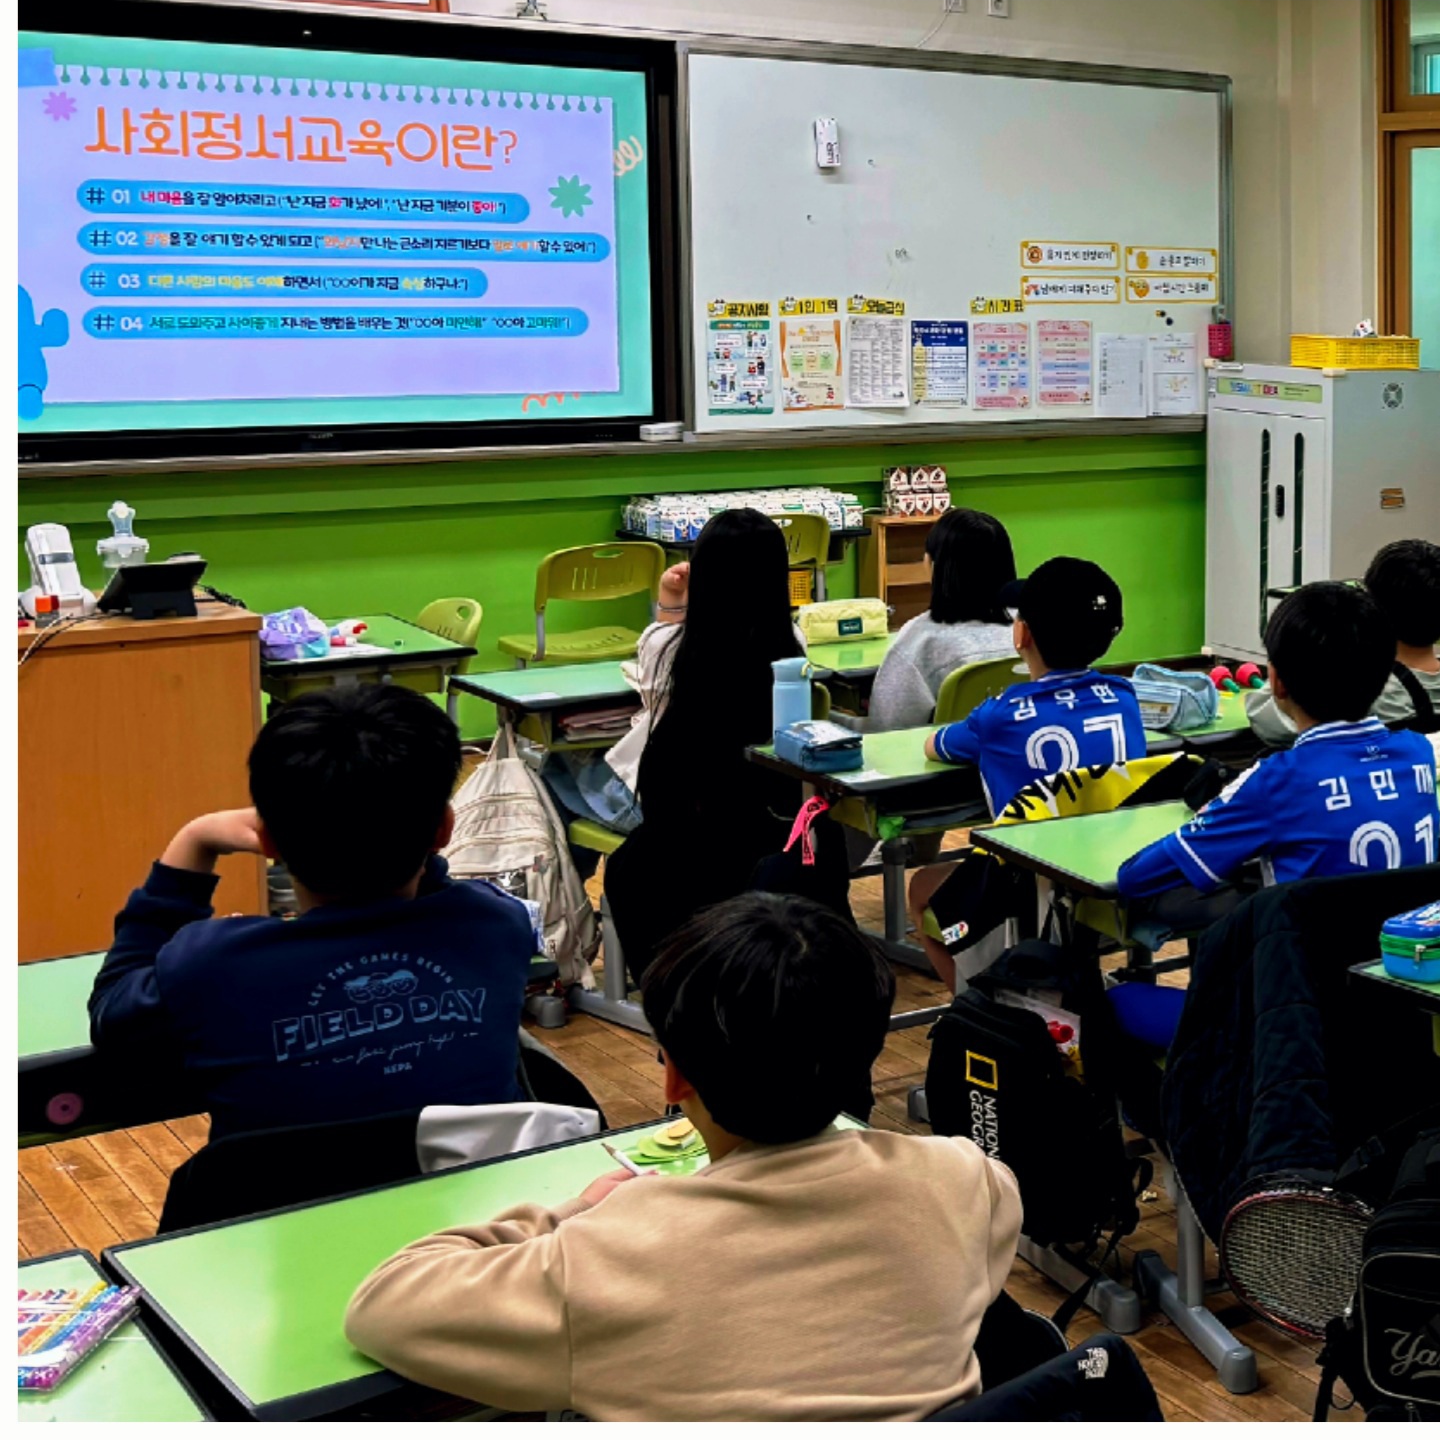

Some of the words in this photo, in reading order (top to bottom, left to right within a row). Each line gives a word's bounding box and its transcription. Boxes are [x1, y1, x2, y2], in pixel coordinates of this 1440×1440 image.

[84, 105, 518, 172] 사회정서교육이란?
[111, 189, 131, 204] 01
[141, 191, 155, 203] 내
[197, 191, 211, 207] 잘
[115, 231, 138, 246] 02
[118, 274, 140, 289] 03
[120, 316, 143, 331] 04
[272, 1002, 404, 1062] FIELD
[408, 987, 486, 1024] DAY
